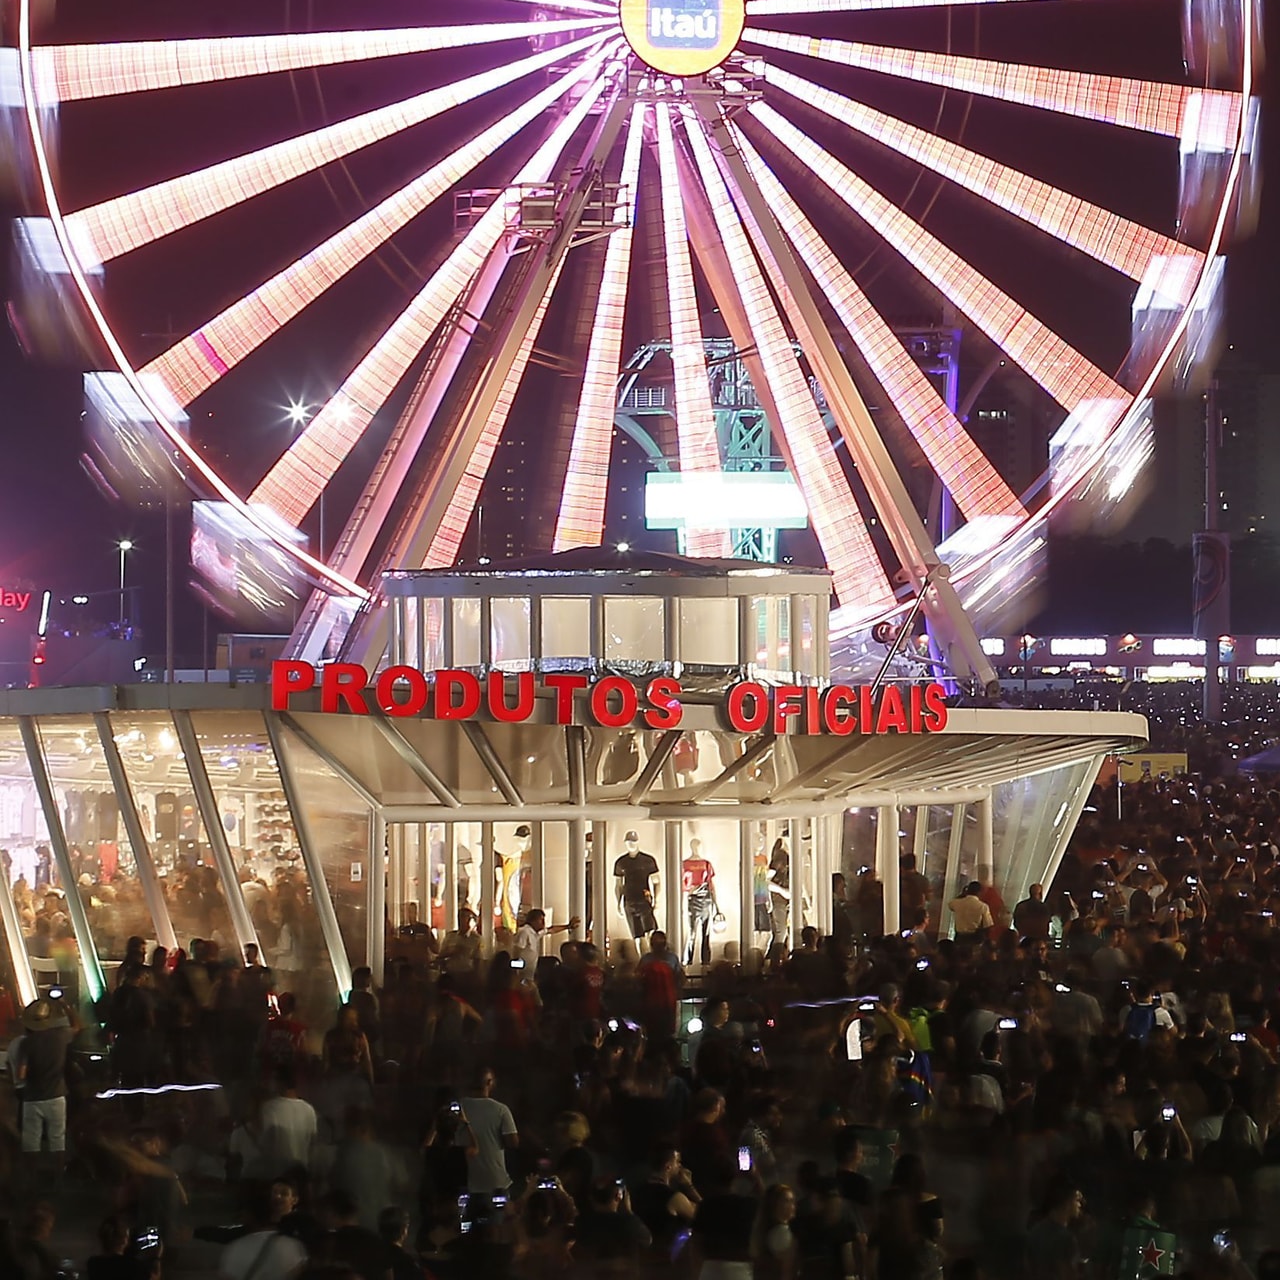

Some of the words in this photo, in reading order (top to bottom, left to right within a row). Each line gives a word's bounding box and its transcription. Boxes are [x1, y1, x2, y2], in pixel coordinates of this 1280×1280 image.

[651, 7, 717, 38] Itaú
[271, 659, 684, 729] PRODUTOS
[728, 681, 949, 736] OFICIAIS
